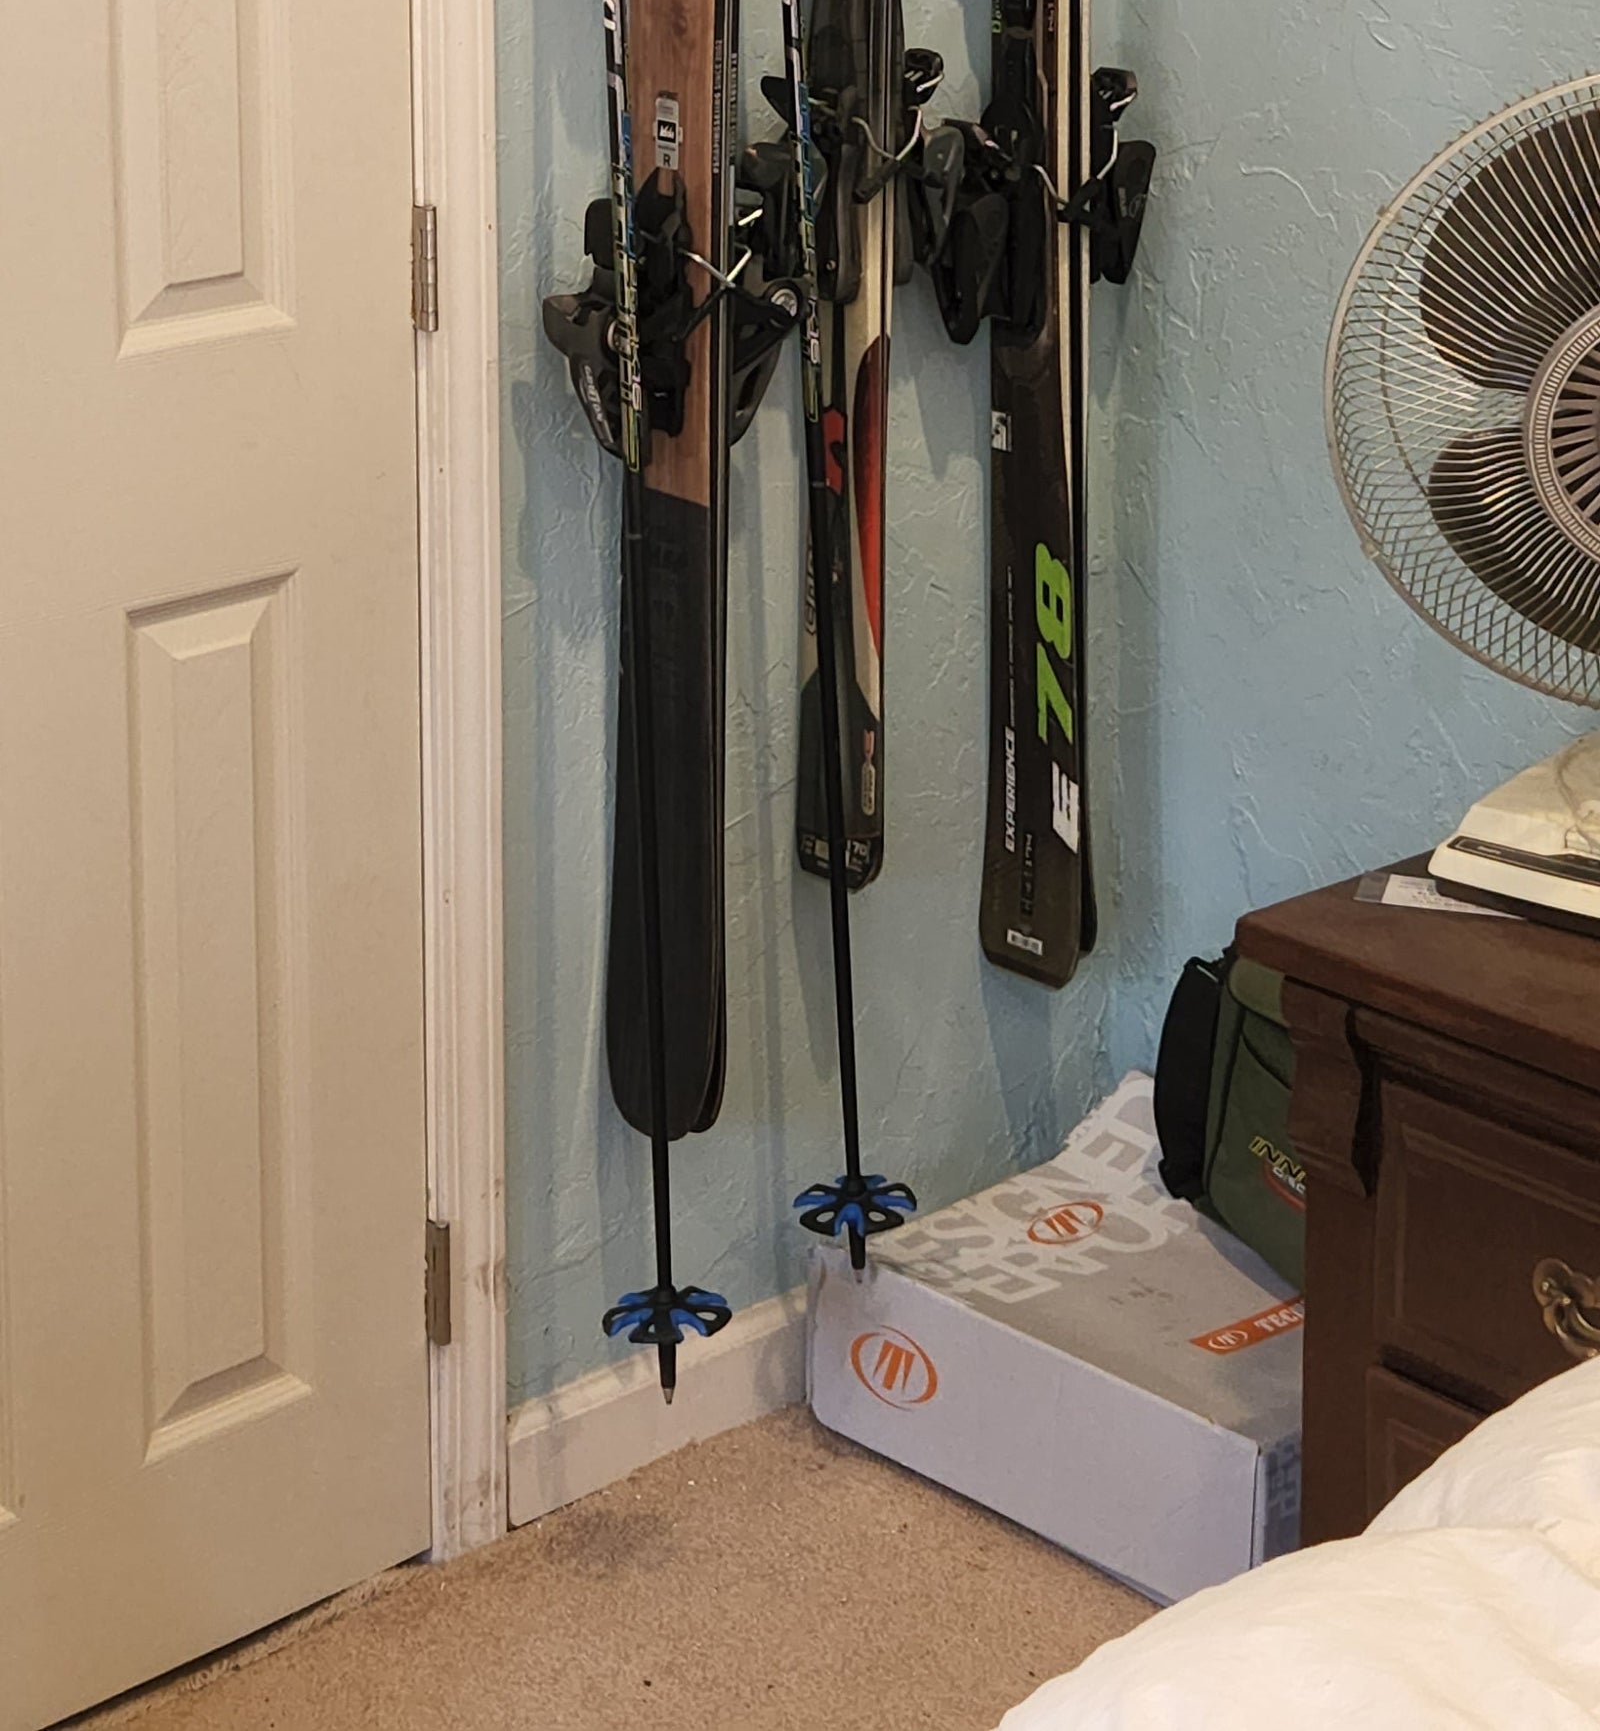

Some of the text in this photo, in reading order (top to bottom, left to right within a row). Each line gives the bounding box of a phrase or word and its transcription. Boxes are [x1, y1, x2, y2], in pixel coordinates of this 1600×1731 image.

[663, 153, 672, 168] R
[1034, 542, 1074, 745] 78
[1004, 725, 1015, 854] EXPERIENCE
[1247, 1135, 1307, 1183] INN
